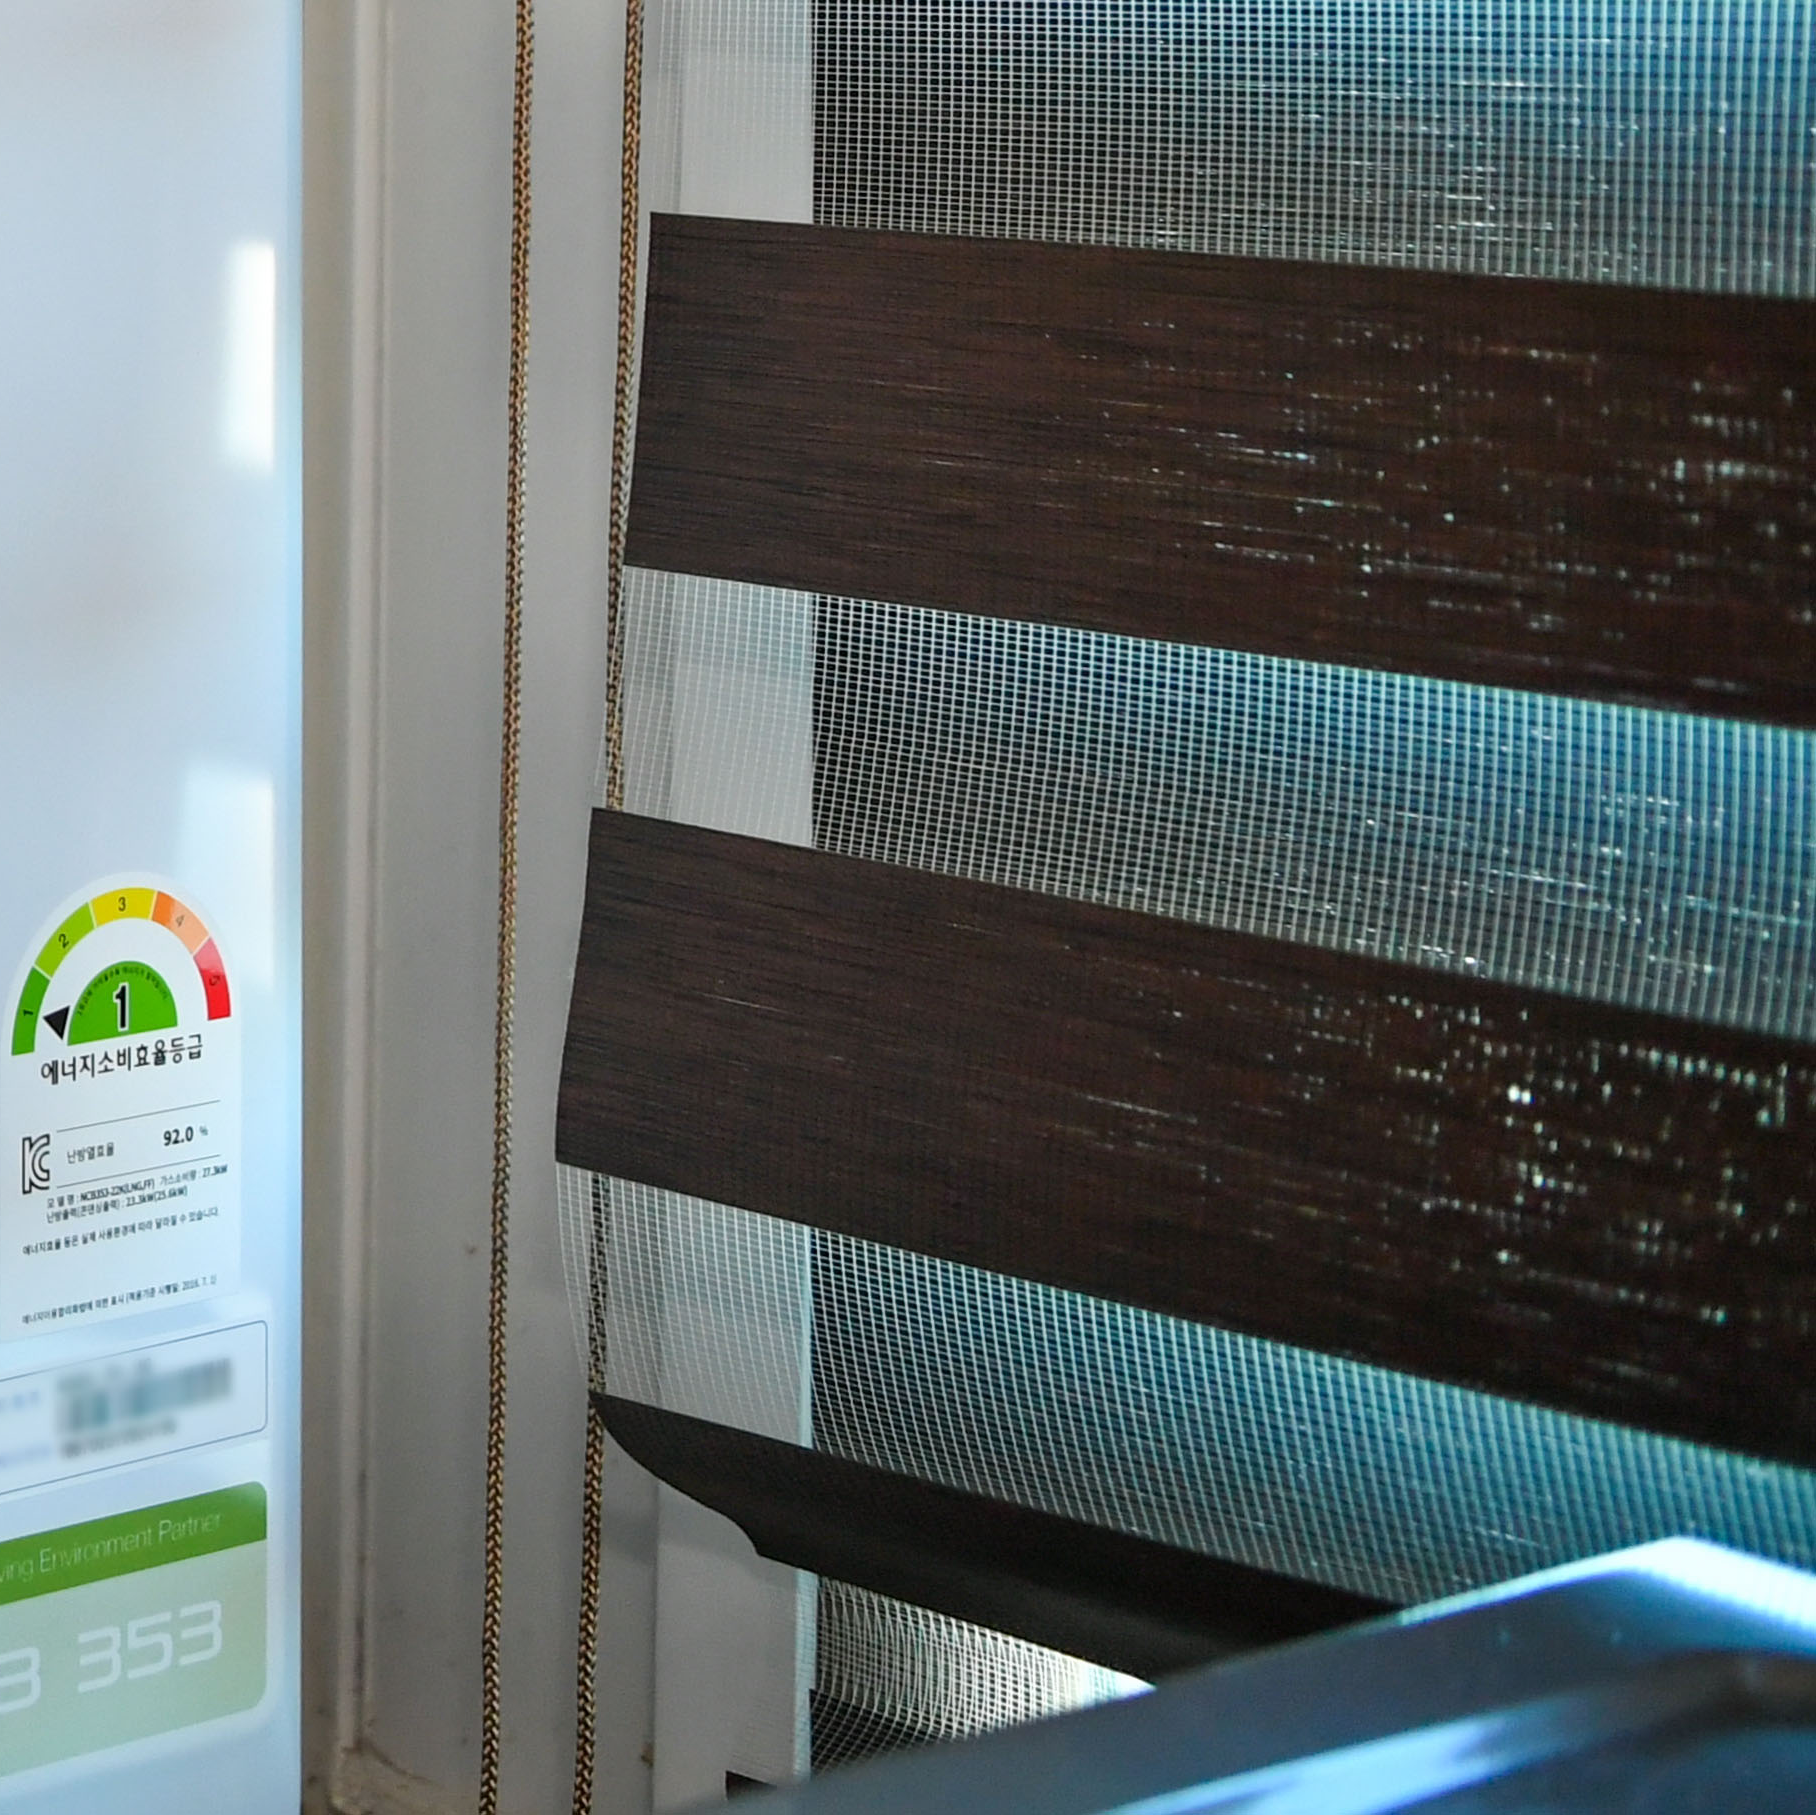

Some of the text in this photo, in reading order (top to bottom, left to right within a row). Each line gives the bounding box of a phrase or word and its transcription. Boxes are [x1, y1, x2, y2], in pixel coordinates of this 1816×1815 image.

[118, 896, 127, 912] 3
[175, 914, 185, 927] 4
[58, 933, 69, 949] 2
[23, 1008, 34, 1017] 1
[115, 983, 127, 1029] 1
[40, 1033, 203, 1086] 에너지소비효율등급
[163, 1125, 194, 1147] 92.0
[67, 1141, 115, 1165] 난방열효율
[39, 1527, 153, 1574] Environment
[158, 1509, 223, 1545] Partner
[77, 1600, 223, 1693] 353
